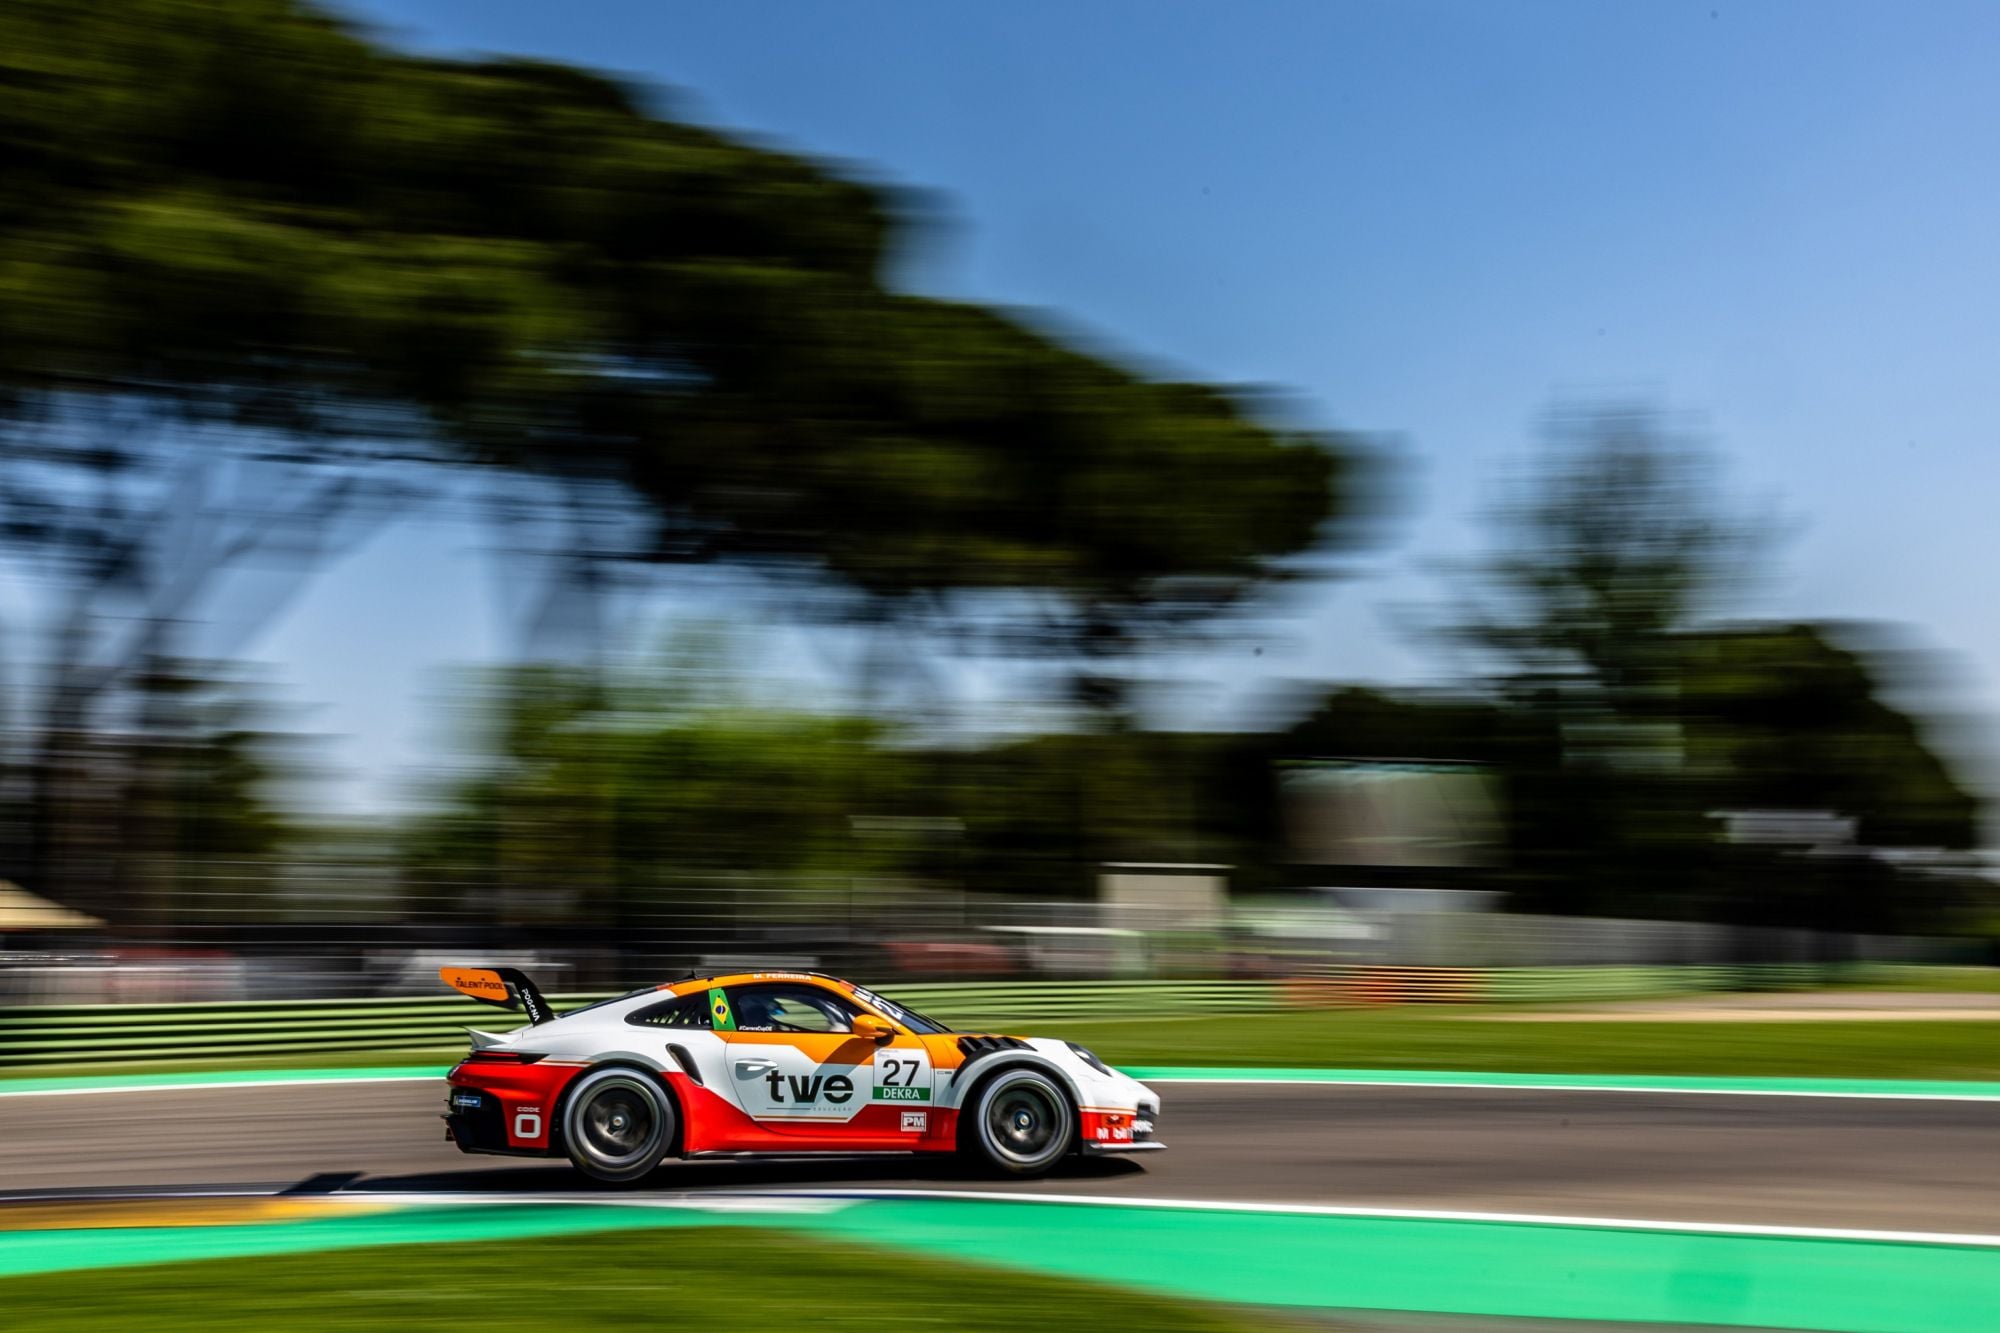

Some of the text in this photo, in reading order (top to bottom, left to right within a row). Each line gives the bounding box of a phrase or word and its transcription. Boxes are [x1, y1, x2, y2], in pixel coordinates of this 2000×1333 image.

[766, 973, 812, 981] FERREIRA
[484, 981, 505, 990] POOL
[882, 1058, 921, 1087] 27
[765, 1069, 854, 1104] twe
[883, 1087, 920, 1099] DEKRA
[903, 1115, 925, 1128] PM
